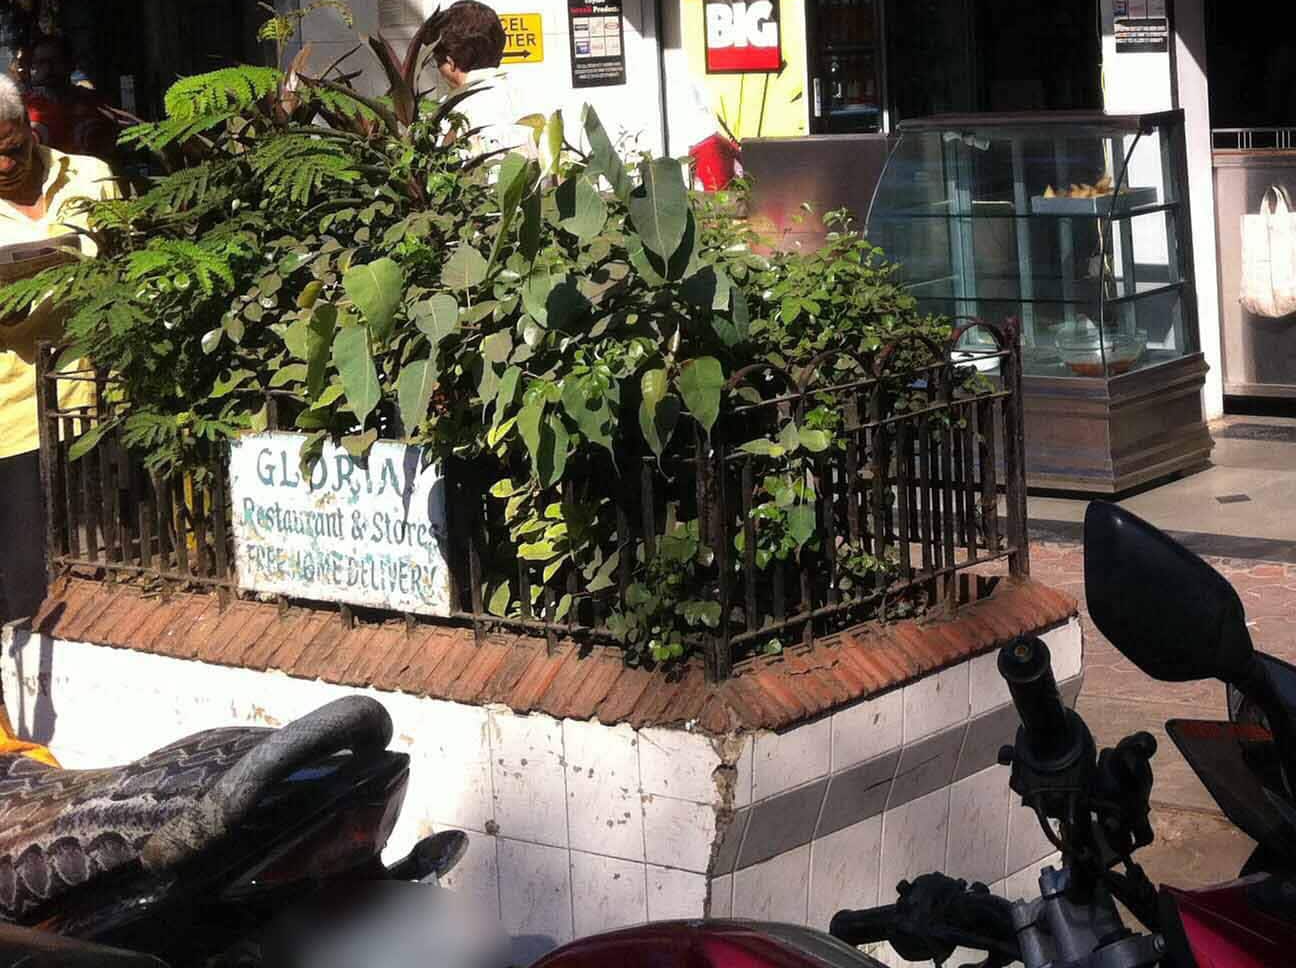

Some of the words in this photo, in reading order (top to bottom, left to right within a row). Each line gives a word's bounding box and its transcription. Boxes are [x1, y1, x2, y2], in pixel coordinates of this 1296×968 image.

[257, 447, 403, 497] GLORIA
[240, 497, 345, 540] Restaurant
[351, 509, 369, 541] &
